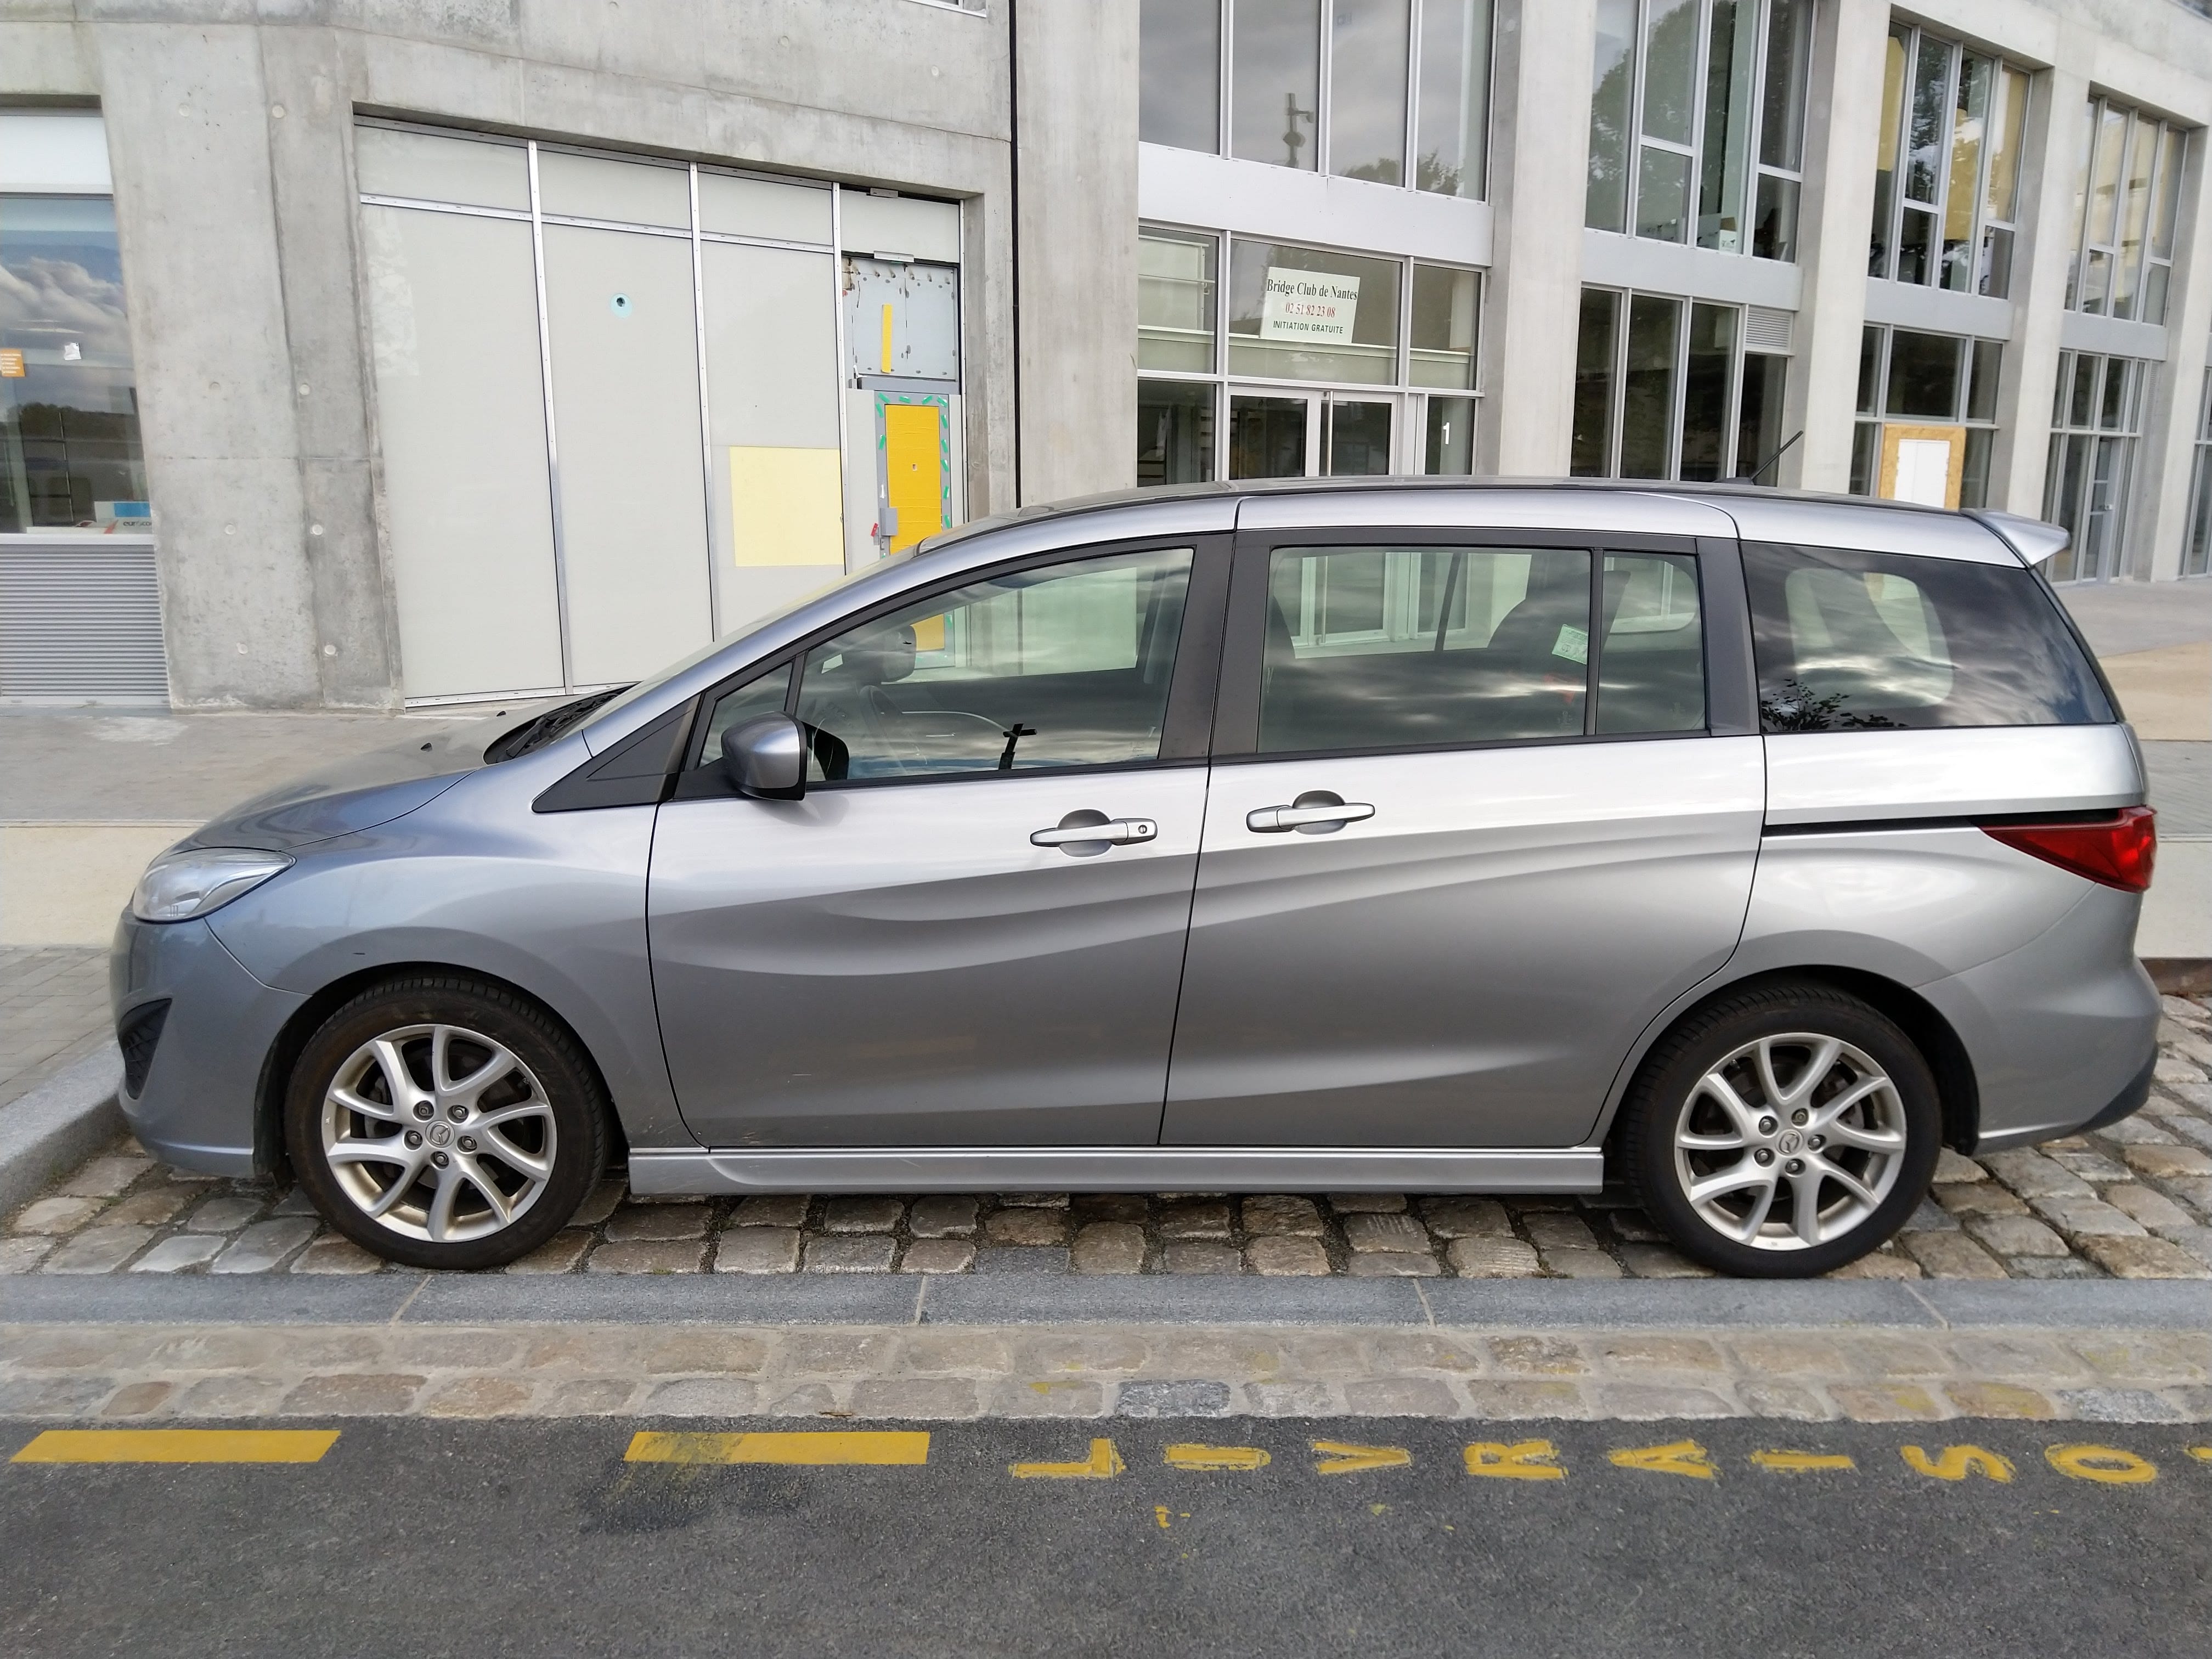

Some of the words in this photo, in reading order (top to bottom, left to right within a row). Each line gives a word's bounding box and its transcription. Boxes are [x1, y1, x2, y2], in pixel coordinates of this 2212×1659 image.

[1266, 279, 1295, 297] Bridge
[1297, 282, 1317, 296] Club
[1319, 285, 1329, 297] de
[1330, 285, 1358, 301] Nantes
[1285, 302, 1294, 314] 02
[1295, 303, 1304, 315] 51
[1306, 304, 1315, 316] 82
[1317, 306, 1325, 317] 23
[1327, 307, 1336, 318] 08
[1273, 320, 1309, 331] INITIATION
[1312, 324, 1344, 334] GRATUITE
[1443, 422, 1450, 445] 1
[1008, 1437, 2212, 1485] LIVRAISO
